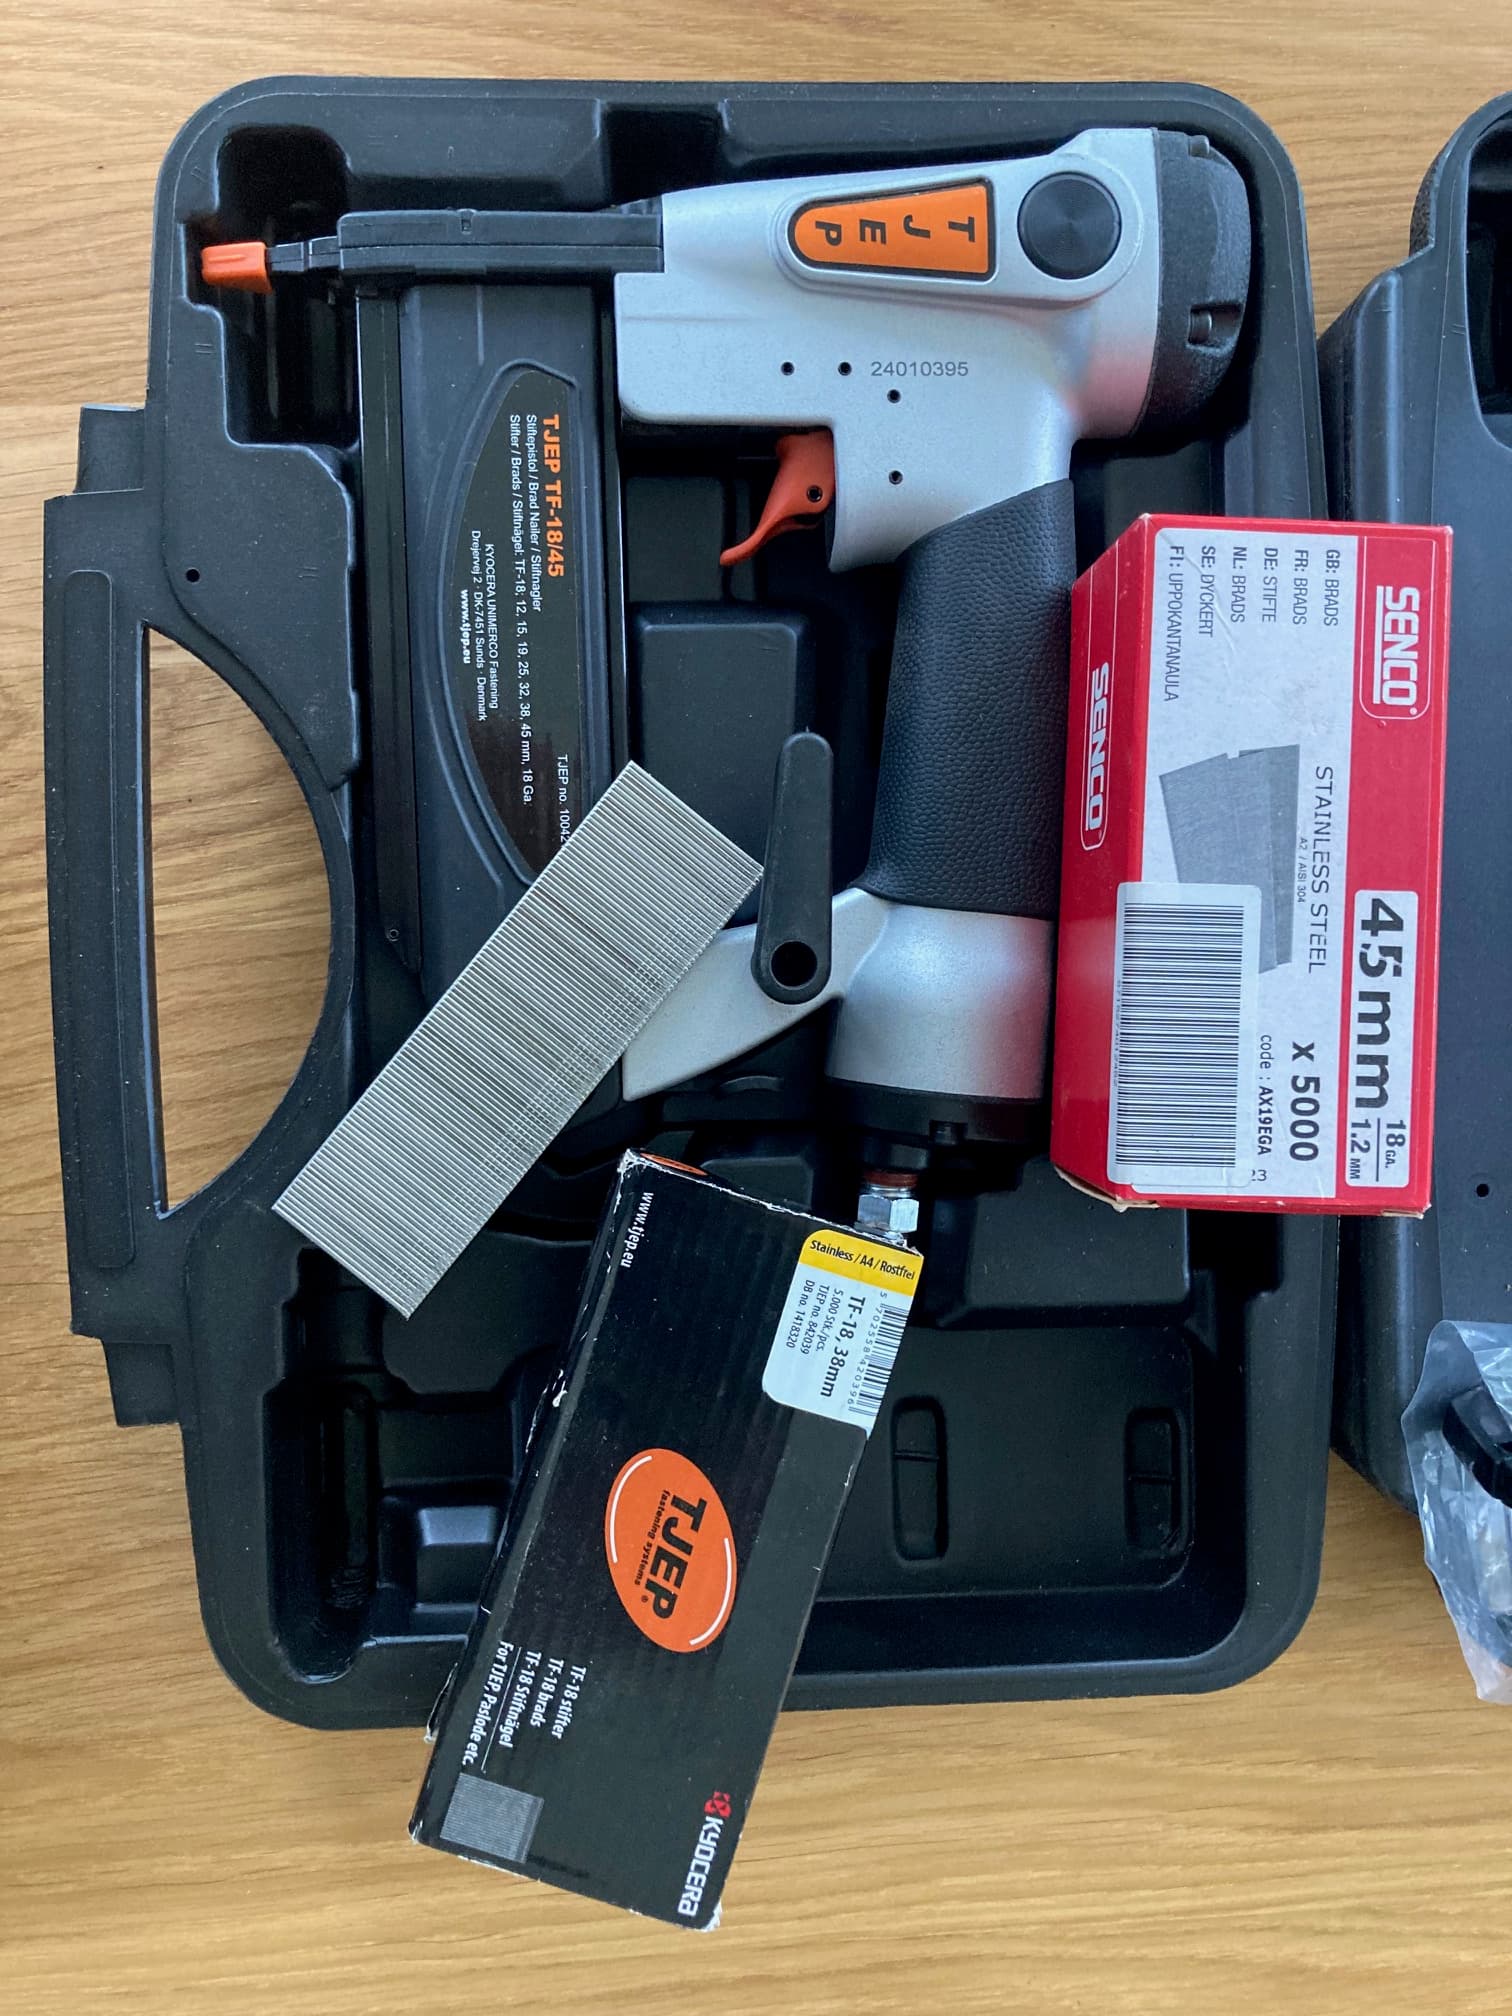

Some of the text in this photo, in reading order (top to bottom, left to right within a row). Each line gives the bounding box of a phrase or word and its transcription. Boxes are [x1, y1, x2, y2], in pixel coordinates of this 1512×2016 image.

[814, 214, 976, 249] TJEP
[870, 360, 969, 377] 24010395
[509, 414, 521, 447] Stifter
[524, 413, 538, 472] Stiftepistol
[510, 457, 522, 490] Brads
[528, 482, 539, 508] Brad
[542, 414, 564, 577] TJEP TF-18/45
[469, 530, 482, 574] Drejervej
[529, 511, 540, 545] Nailer
[514, 558, 526, 595] TF-18;
[529, 554, 543, 611] Stiftnagler
[1198, 545, 1215, 637] SE: DYCKERT
[1229, 546, 1246, 623] NL: BRADS
[1261, 547, 1277, 622] DE: STIFTE
[1291, 549, 1308, 625] FR: BRADS
[1322, 548, 1340, 626] GB: BRADS
[459, 589, 470, 663] www.tjep.eu
[473, 591, 483, 633] DK-7451
[484, 543, 499, 708] KYOCERA UNIMERCO Fastening
[515, 600, 527, 616] 12,
[515, 621, 527, 637] 15,
[1163, 545, 1183, 701] FI: UPPOKANTANAULA
[474, 637, 485, 668] Sunds
[516, 641, 528, 658] 19,
[517, 661, 529, 678] 25,
[1381, 586, 1420, 705] SENCO
[476, 676, 487, 721] Denmark
[518, 682, 530, 699] 32,
[518, 703, 531, 720] 38,
[520, 723, 531, 737] 45
[520, 740, 530, 764] mm,
[1087, 661, 1110, 831] SENCO
[522, 768, 533, 782] 18
[522, 785, 534, 805] Ga.
[556, 753, 570, 849] TJEP no. 10042
[1298, 837, 1307, 850] A2
[1297, 862, 1306, 882] AISI
[1308, 765, 1333, 973] STAINLESS STEEL
[1296, 885, 1305, 902] 304
[1259, 1034, 1275, 1069] code
[1257, 1085, 1273, 1155] AX19EGA
[1288, 1041, 1320, 1161] x 5000
[1349, 1118, 1371, 1179] 1.2 MM
[1384, 1119, 1406, 1168] 18 GA.
[619, 1191, 654, 1268] www.tjep.eu
[809, 1239, 854, 1261] Stainless
[859, 1254, 874, 1268] A4
[785, 1279, 815, 1348] DB no. 1418320
[799, 1284, 829, 1354] TJEP no. 842039
[827, 1287, 844, 1314] 5.000
[819, 1295, 866, 1397] TF-18, 38mm
[862, 1306, 882, 1353] 702558
[846, 1358, 866, 1404] 420396
[633, 1489, 670, 1585] fastening systems
[641, 1494, 707, 1619] TJEP
[461, 1640, 514, 1765] For TJEP, Paslode etc.
[498, 1650, 542, 1748] TF-18 Stiftnägel
[529, 1657, 564, 1727] TF-18 brads
[550, 1665, 586, 1739] TF-18 stifter
